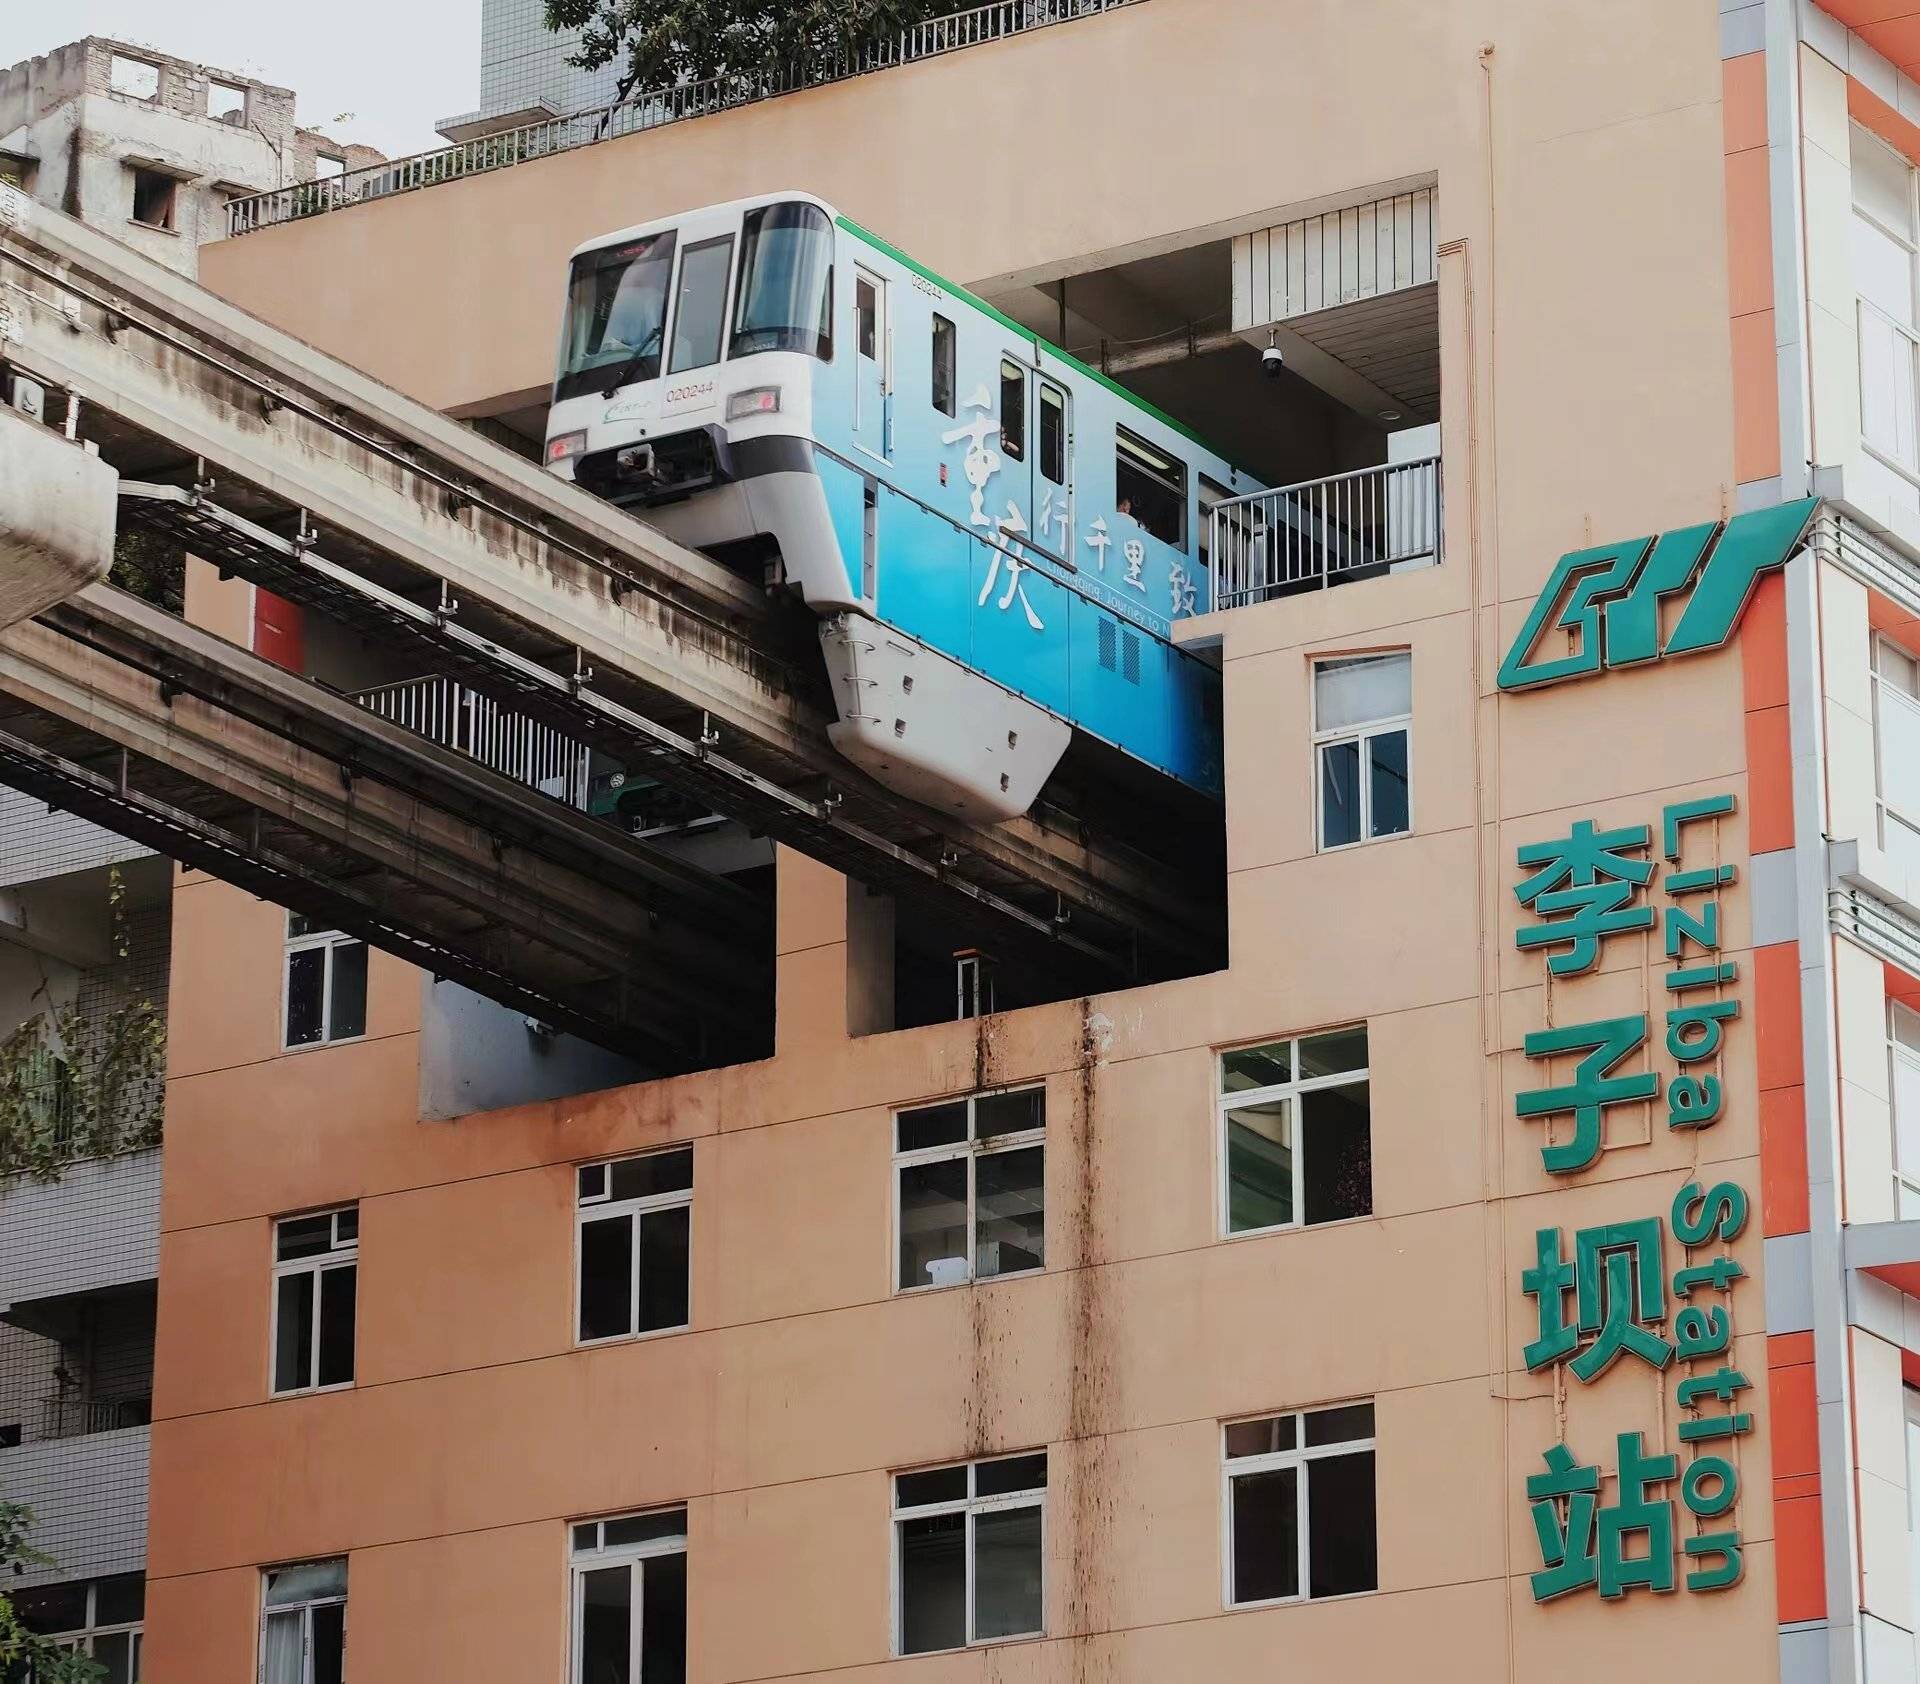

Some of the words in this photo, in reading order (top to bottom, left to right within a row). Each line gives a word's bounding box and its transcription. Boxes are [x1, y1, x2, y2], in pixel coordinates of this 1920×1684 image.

[666, 383, 713, 402] 020244
[1106, 591, 1145, 621] Journey
[1663, 794, 1741, 1132] Liziba
[1513, 819, 1679, 1604] 李子坝站
[1671, 1181, 1754, 1592] Station
